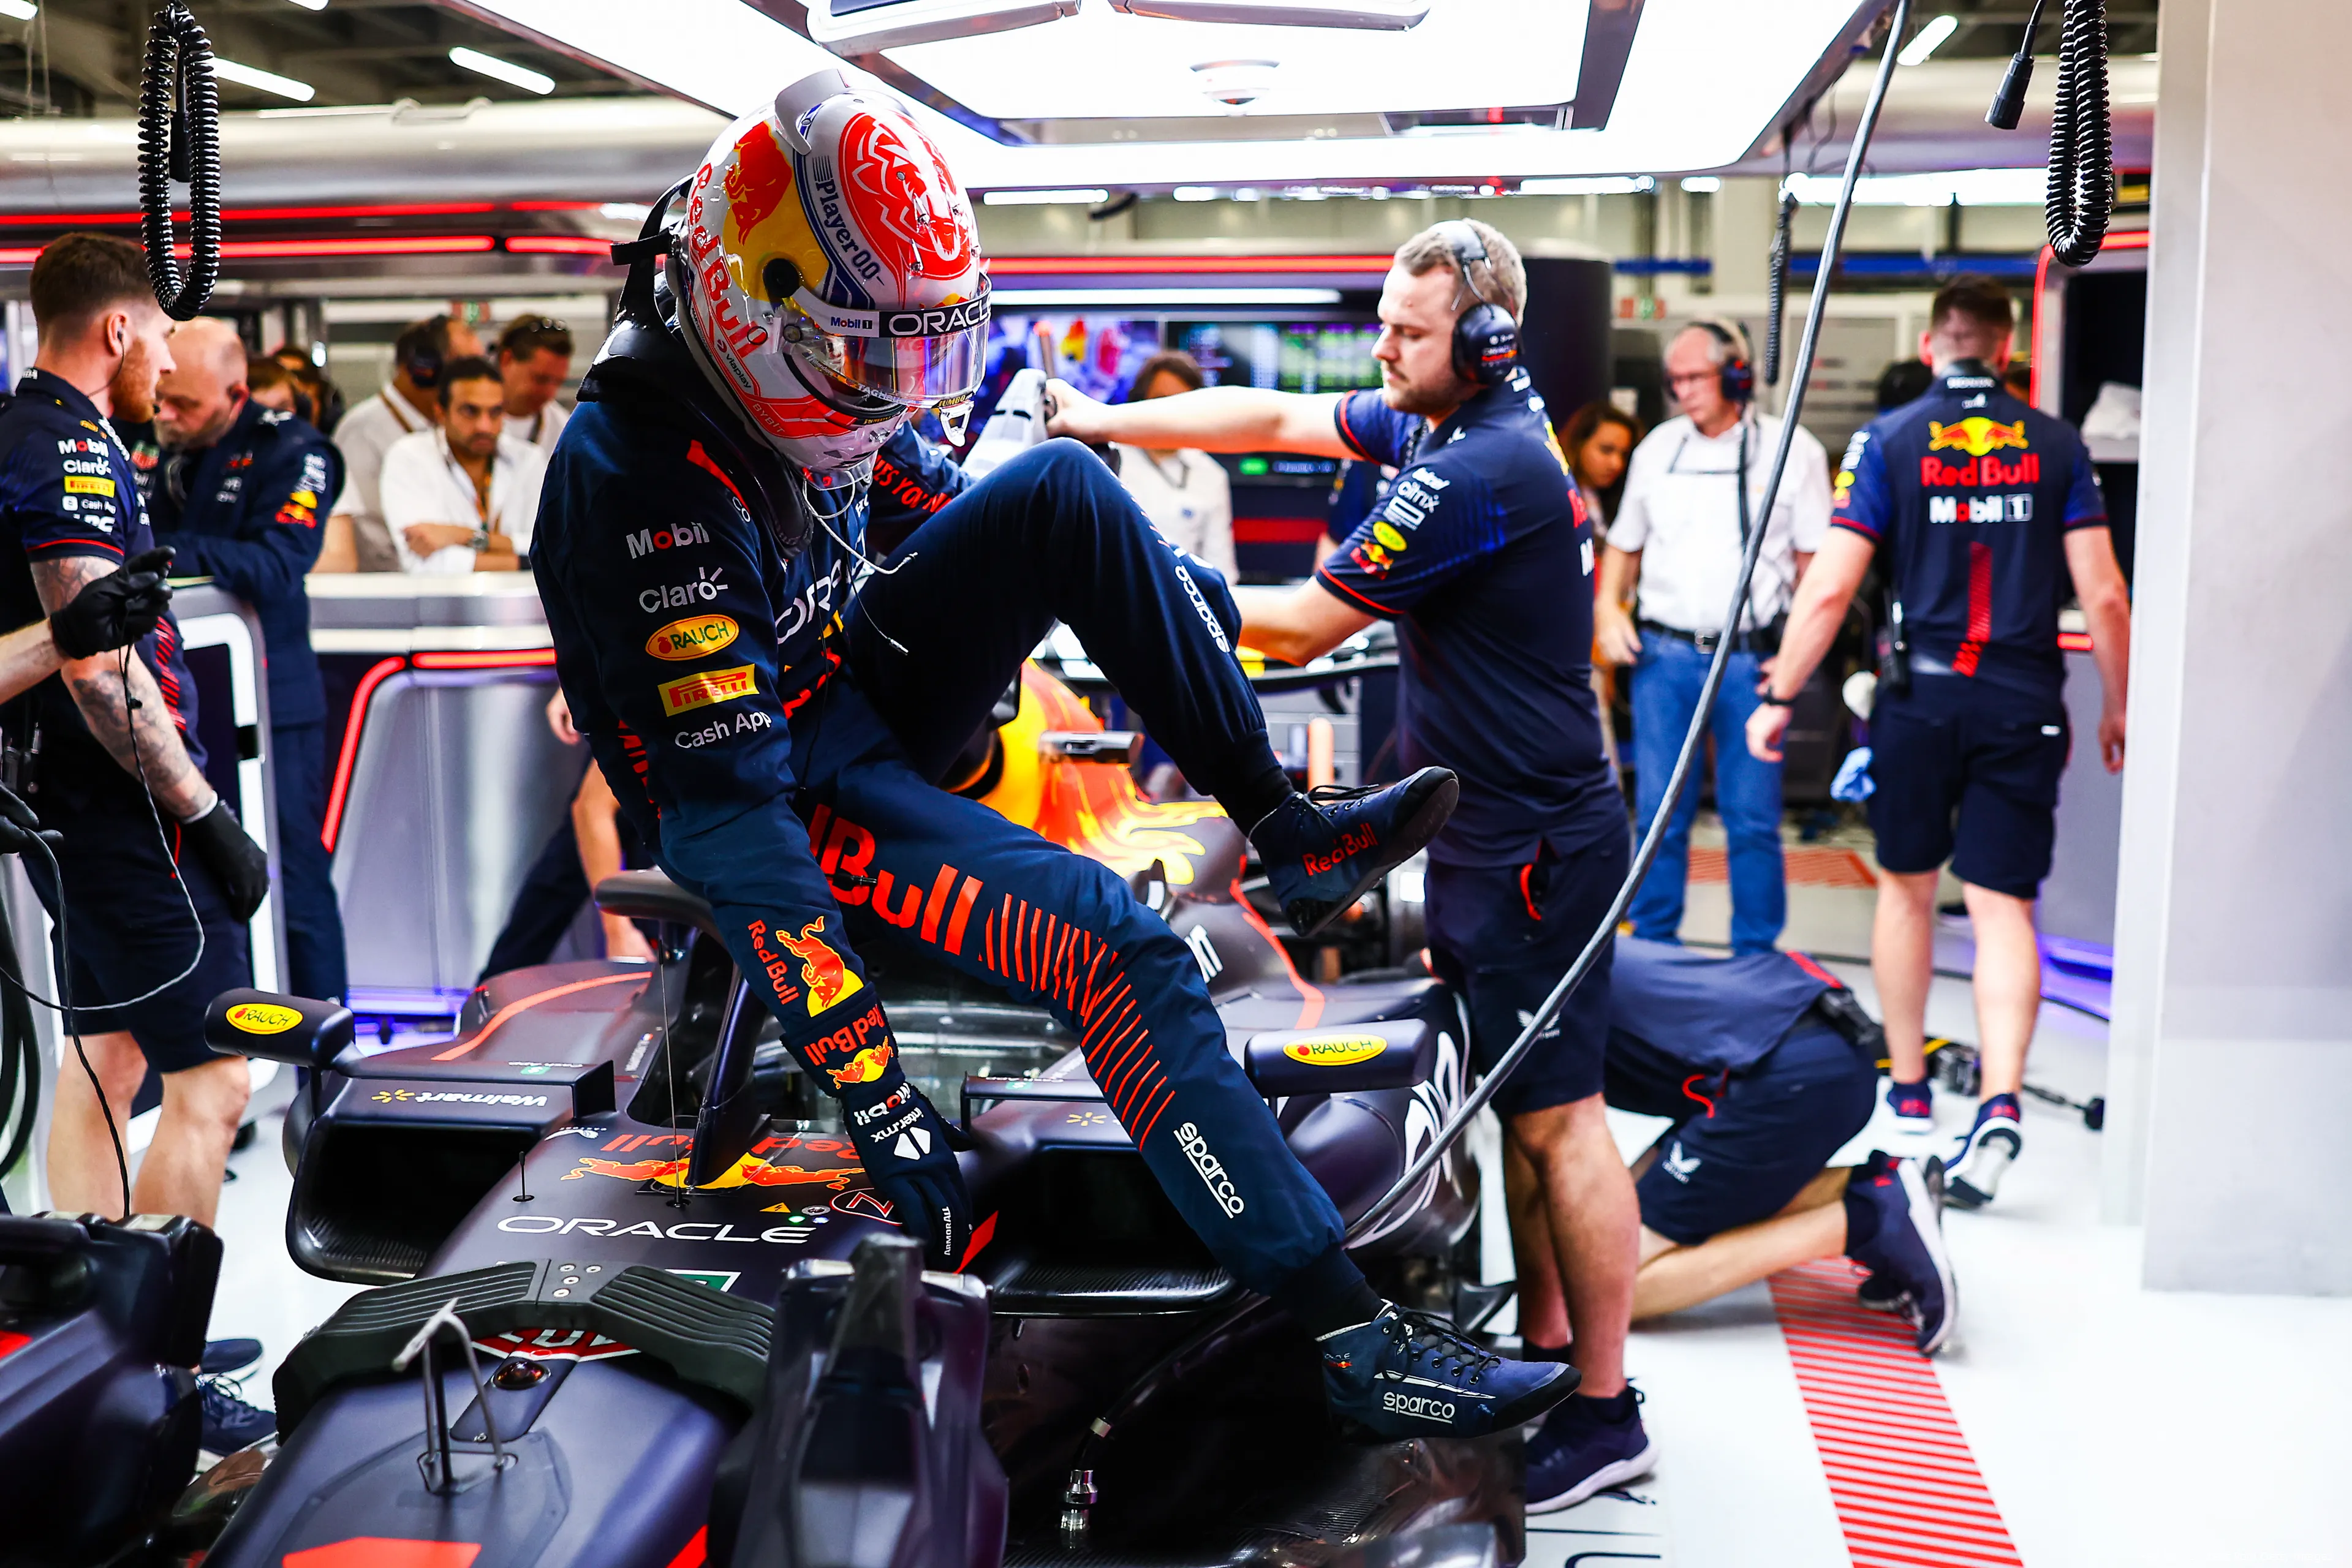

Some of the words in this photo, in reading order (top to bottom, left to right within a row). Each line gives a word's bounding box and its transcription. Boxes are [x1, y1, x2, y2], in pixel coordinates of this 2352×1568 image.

[815, 178, 859, 253] Player
[830, 317, 860, 330] Mobil
[726, 353, 752, 388] viaplay
[752, 403, 785, 433] BYBIT
[58, 437, 109, 458] Mobil
[62, 458, 110, 475] Claro
[1920, 454, 1979, 487] Red
[1980, 453, 2040, 487] Bull
[1929, 494, 2003, 524] Mobil
[626, 521, 710, 559] Mobil
[639, 575, 722, 613] Claro
[1174, 565, 1230, 654] sparco
[671, 621, 730, 650] RAUCH
[668, 672, 747, 708] PIRELLI
[675, 721, 730, 748] Cash
[735, 710, 772, 734] App
[1341, 823, 1379, 856] Bull
[820, 816, 984, 956] Bull
[747, 919, 779, 963] Red
[766, 960, 800, 1005] Bull
[243, 1009, 293, 1027] RAUCH
[852, 1003, 885, 1046] Red
[804, 1026, 858, 1066] Bull
[1310, 1040, 1374, 1055] RAUCH
[415, 1091, 548, 1107] Walmart
[853, 1082, 912, 1126] Mobil
[870, 1106, 925, 1143] inter.mx
[600, 1134, 694, 1152] ull
[1176, 1122, 1245, 1216] sparco
[497, 1216, 817, 1244] ORACLE
[1382, 1392, 1456, 1422] sparco
